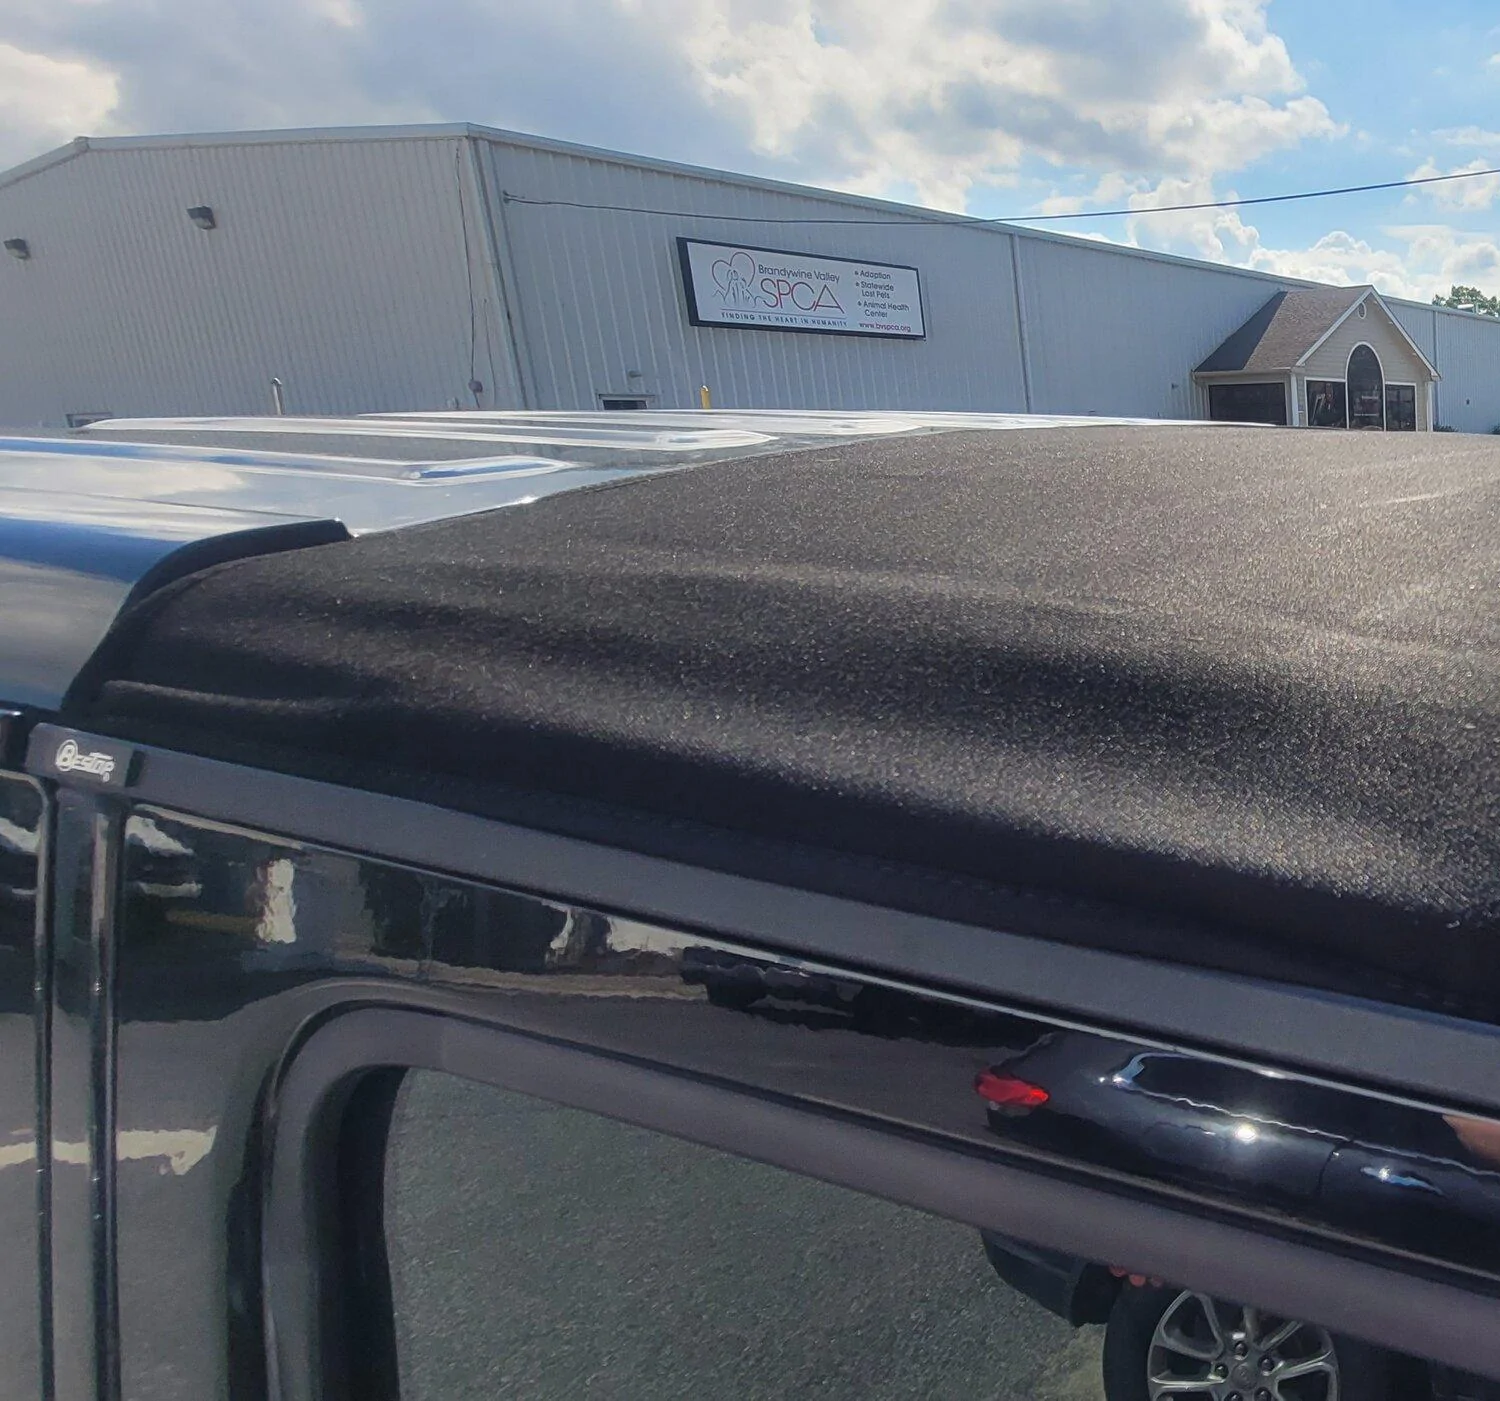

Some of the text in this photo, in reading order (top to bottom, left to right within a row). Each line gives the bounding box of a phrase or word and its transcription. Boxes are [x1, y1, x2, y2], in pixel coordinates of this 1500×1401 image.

[758, 264, 840, 284] Brandywine Valley
[860, 270, 891, 280] Adoption
[861, 281, 894, 292] Statewide
[760, 278, 845, 314] SPCA
[862, 290, 890, 299] Lost Pets
[863, 301, 910, 311] Animal Health
[721, 312, 756, 321] FINDING
[864, 310, 888, 318] Center
